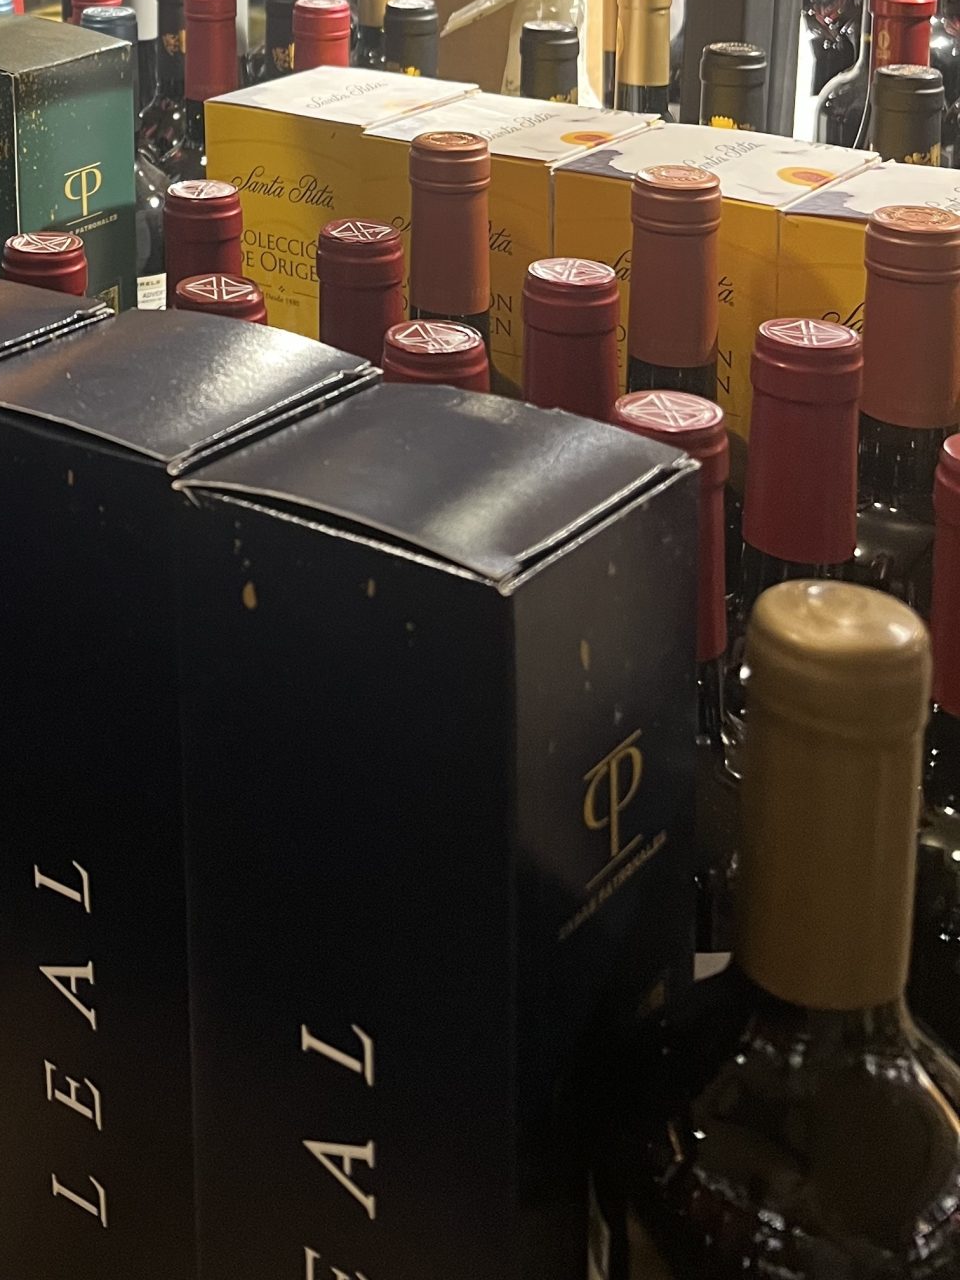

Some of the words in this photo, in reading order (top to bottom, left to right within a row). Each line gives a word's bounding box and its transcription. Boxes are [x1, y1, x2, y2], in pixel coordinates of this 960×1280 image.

[232, 165, 285, 198] Santa
[289, 175, 334, 209] Rita
[241, 229, 318, 259] OLECCIÓ
[261, 251, 318, 282] ORIGE
[34, 860, 107, 1228] LEAL
